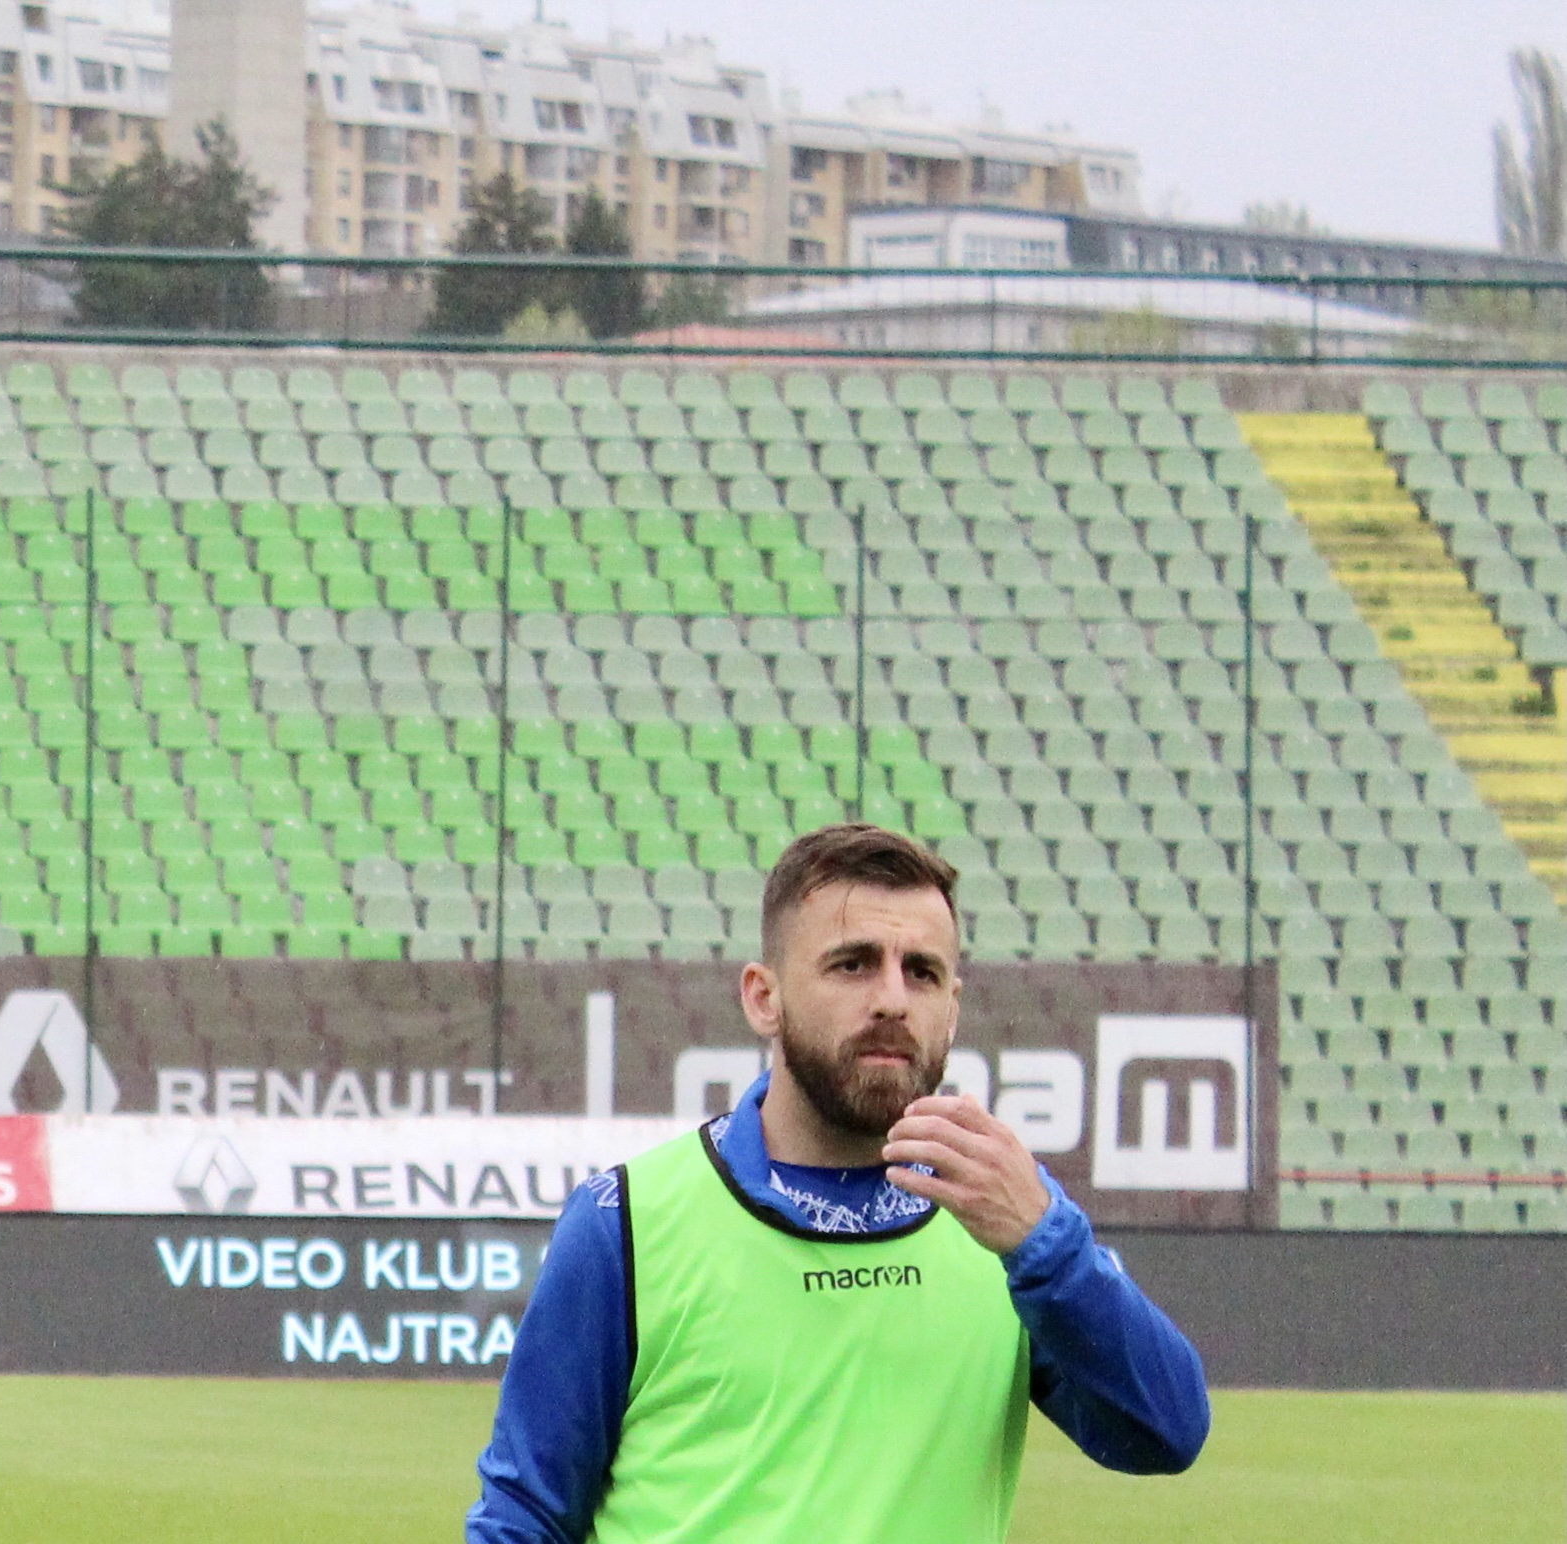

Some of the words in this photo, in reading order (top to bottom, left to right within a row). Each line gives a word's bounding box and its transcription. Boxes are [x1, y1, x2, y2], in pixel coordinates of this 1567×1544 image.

[156, 1068, 513, 1118] RENAULT
[290, 1162, 601, 1210] RENAU
[155, 1238, 347, 1290] VIDEO
[365, 1239, 521, 1291] KLUB
[803, 1265, 922, 1293] macron
